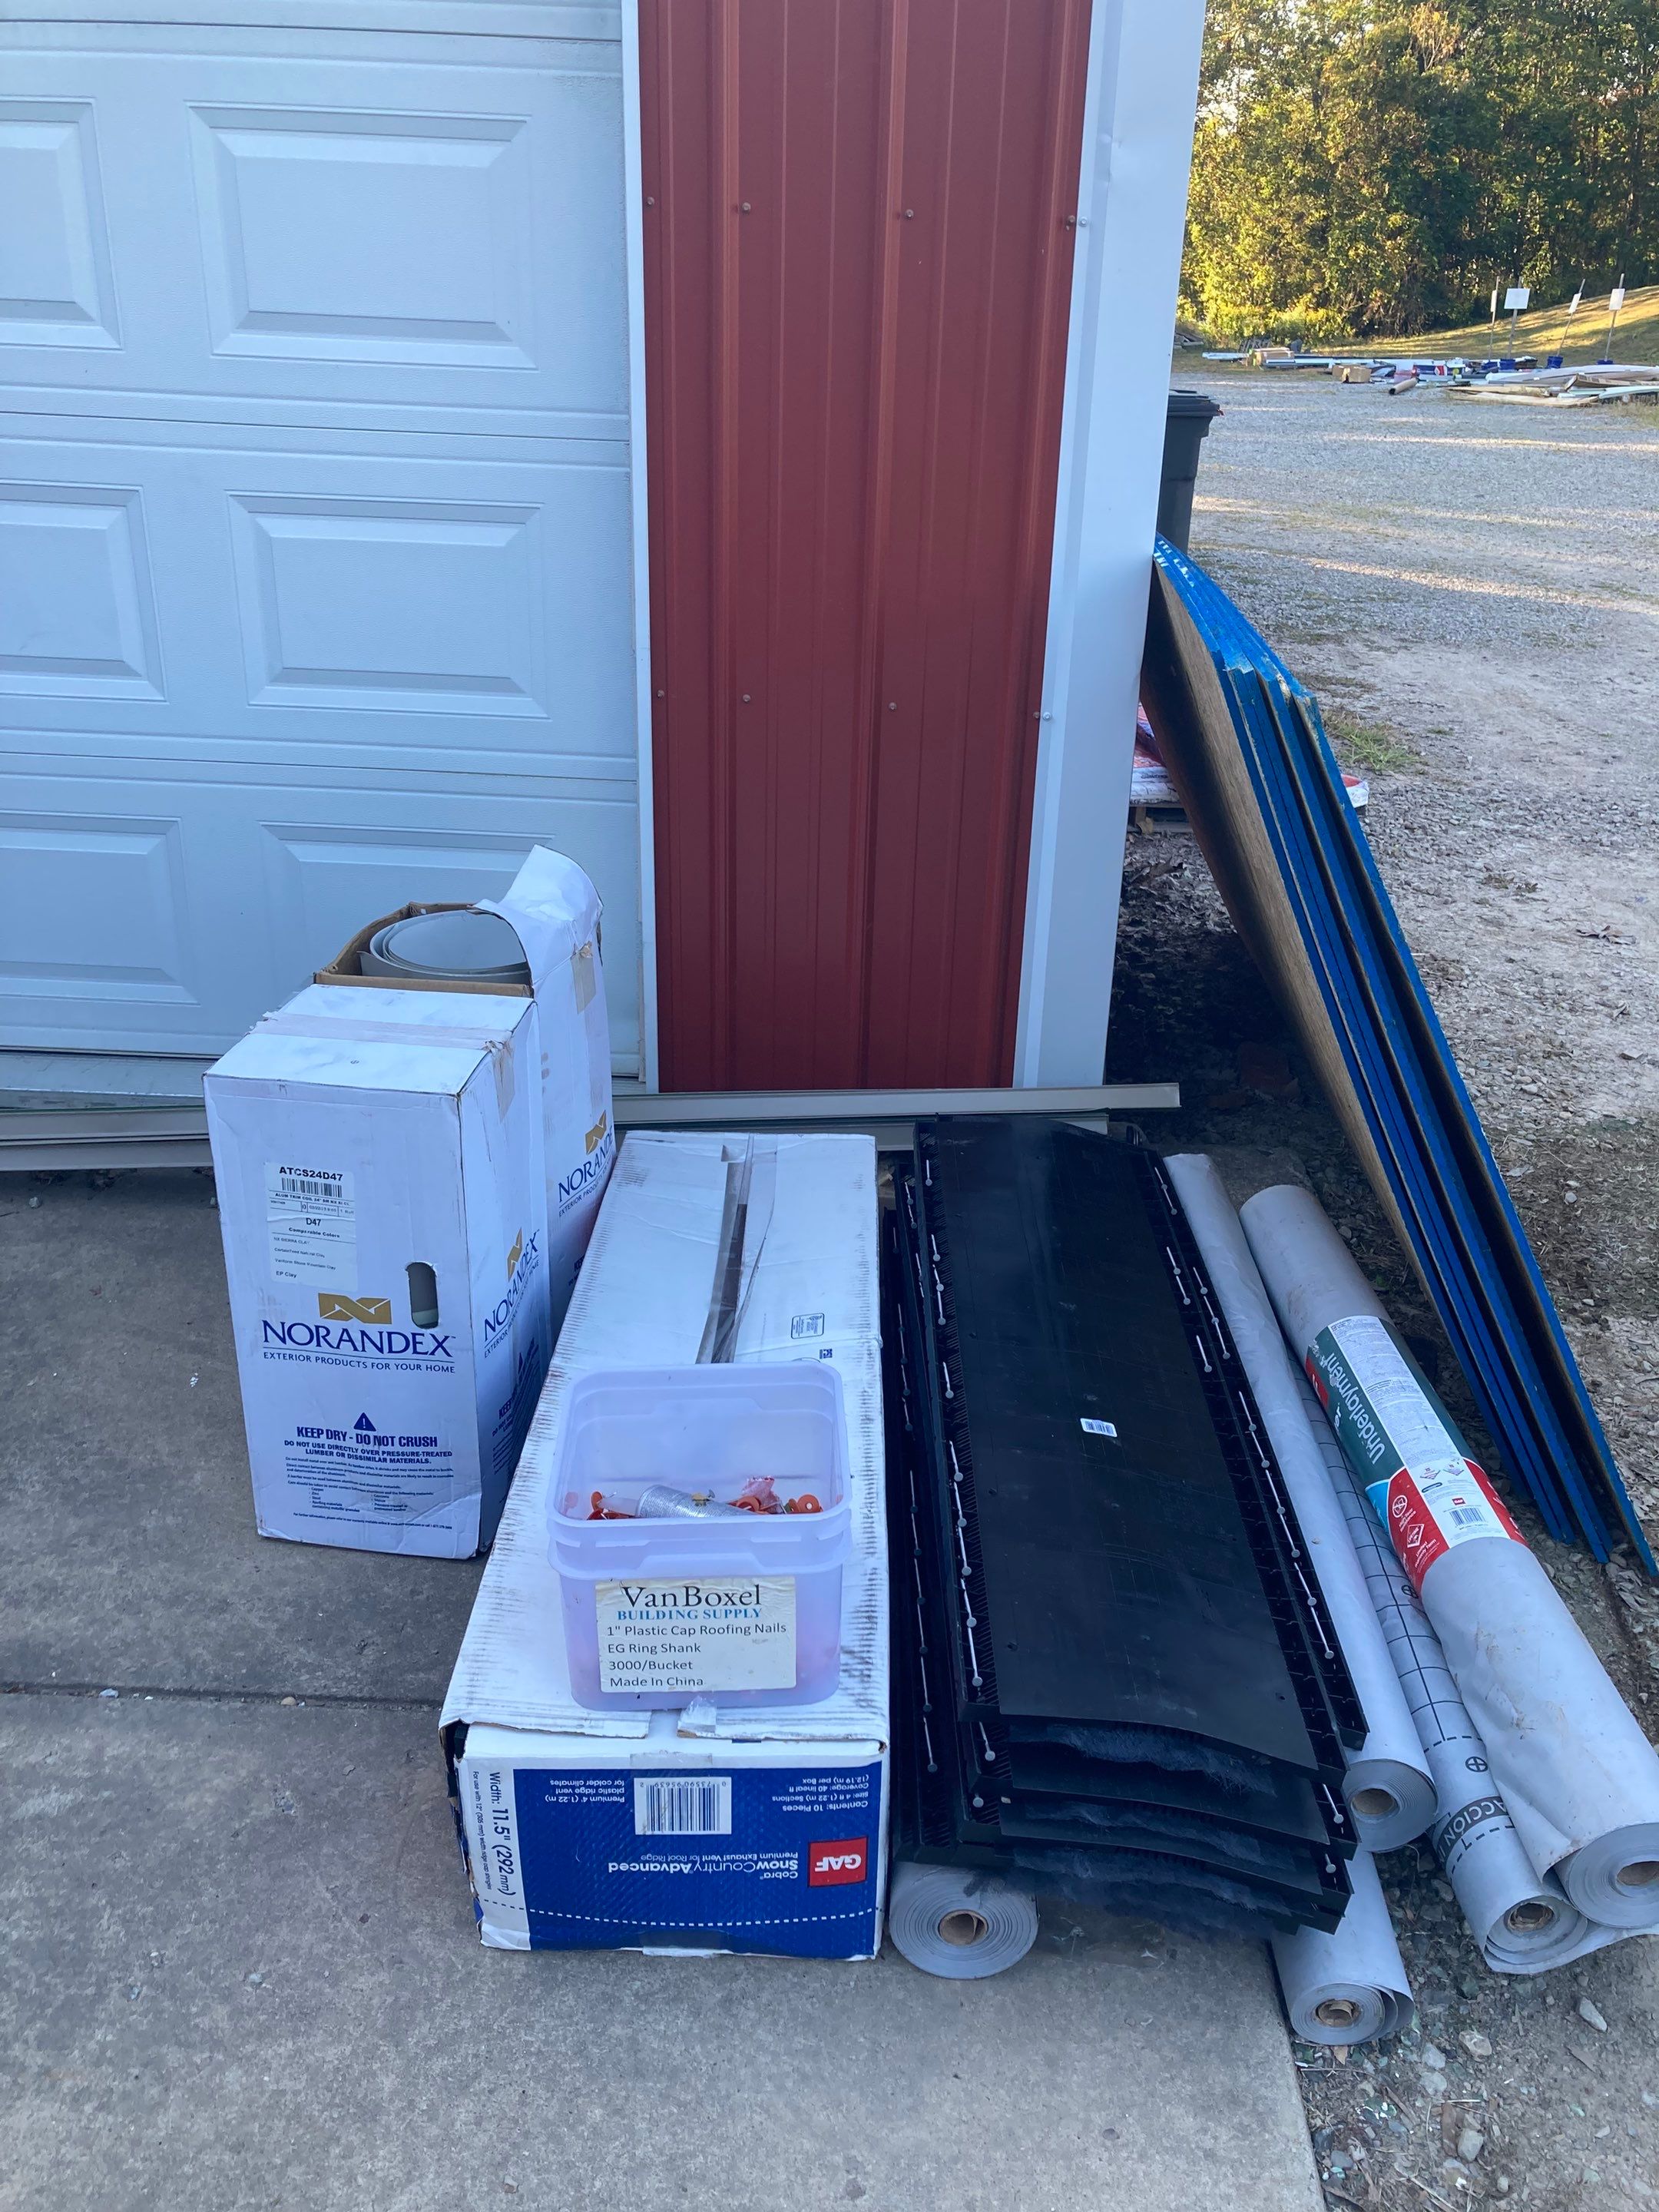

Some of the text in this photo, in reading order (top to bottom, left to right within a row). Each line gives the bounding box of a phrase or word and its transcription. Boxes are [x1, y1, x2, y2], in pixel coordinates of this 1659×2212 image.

[558, 1124, 613, 1203] NORANDE
[279, 1166, 343, 1181] ATCS24D47
[306, 1217, 322, 1227] D47
[288, 1227, 321, 1236] Comparable
[262, 1320, 454, 1357] NORANDEX
[263, 1352, 312, 1363] EXTERIOR
[315, 1356, 368, 1369] PRODUCTS
[371, 1362, 390, 1370] FOR
[426, 1365, 455, 1373] HOME
[1326, 1353, 1386, 1465] Underlayment
[296, 1426, 324, 1438] KEEP
[326, 1429, 347, 1441] DRY
[356, 1433, 370, 1445] DO
[373, 1435, 396, 1446] NOT
[399, 1435, 438, 1448] CRUSH
[327, 1444, 359, 1453] DIRECTLY
[306, 1449, 334, 1457] LUMBER
[347, 1452, 388, 1463] DISSIMILAR
[618, 1608, 762, 1621] BUILDING SUPPLY
[608, 1622, 786, 1638] 1" Plastic Cap Roofing Nails
[608, 1642, 701, 1655] EG Ring Shank
[609, 1660, 694, 1671] 3000/Bucket
[610, 1677, 704, 1687] Made In China
[489, 1772, 502, 1804] Width:
[575, 1786, 596, 1795] ridge
[598, 1786, 625, 1795] plastic
[826, 1800, 869, 1811] Contents:
[492, 1808, 511, 1841] 11.5"
[640, 1853, 665, 1863] Ridge
[667, 1854, 687, 1863] Roof
[724, 1853, 757, 1861] Exhaust
[814, 1853, 862, 1873] GAF
